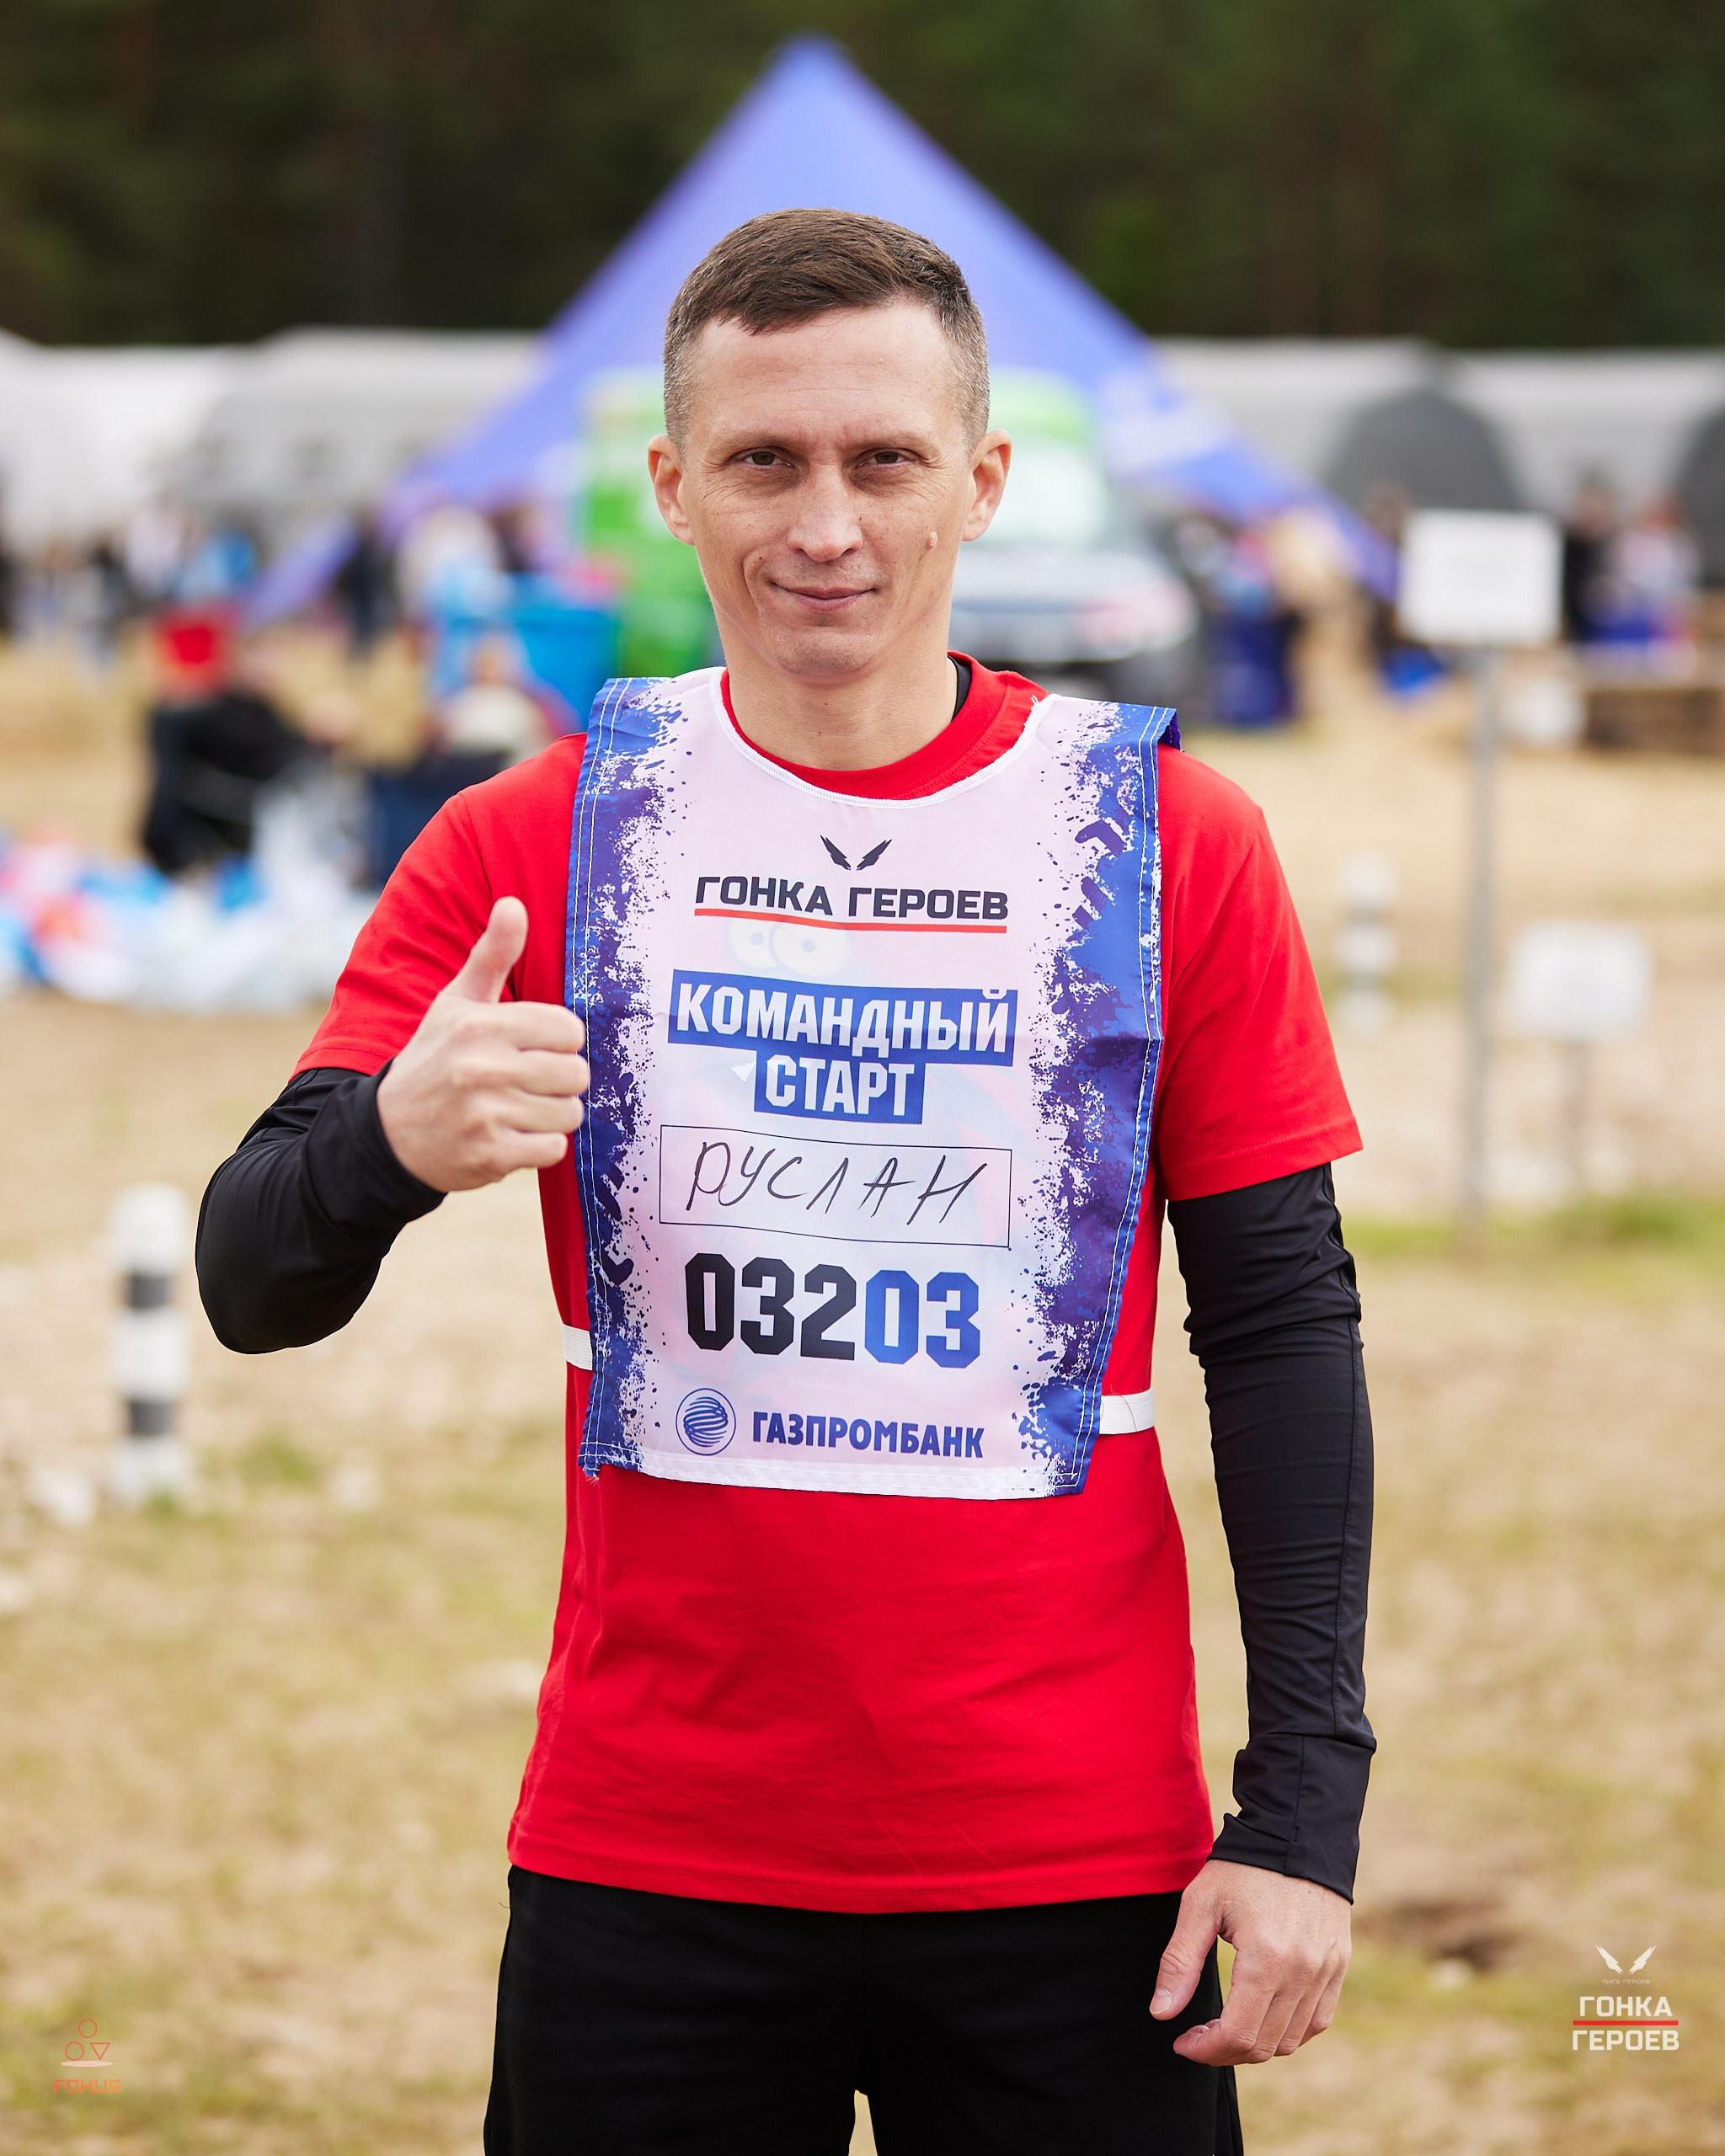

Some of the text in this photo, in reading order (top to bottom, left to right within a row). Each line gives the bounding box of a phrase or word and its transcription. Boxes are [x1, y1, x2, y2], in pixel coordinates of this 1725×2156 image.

[695, 876, 1008, 920] ГОНКА ГЕРОЕВ
[676, 983, 1009, 1059] КОМАНДНЫЙ
[765, 1054, 915, 1117] СТАРТ
[686, 1142, 987, 1225] РУСЛАН
[684, 1252, 980, 1369] 03203
[753, 1411, 985, 1459] ГАЗПРОМБАНК
